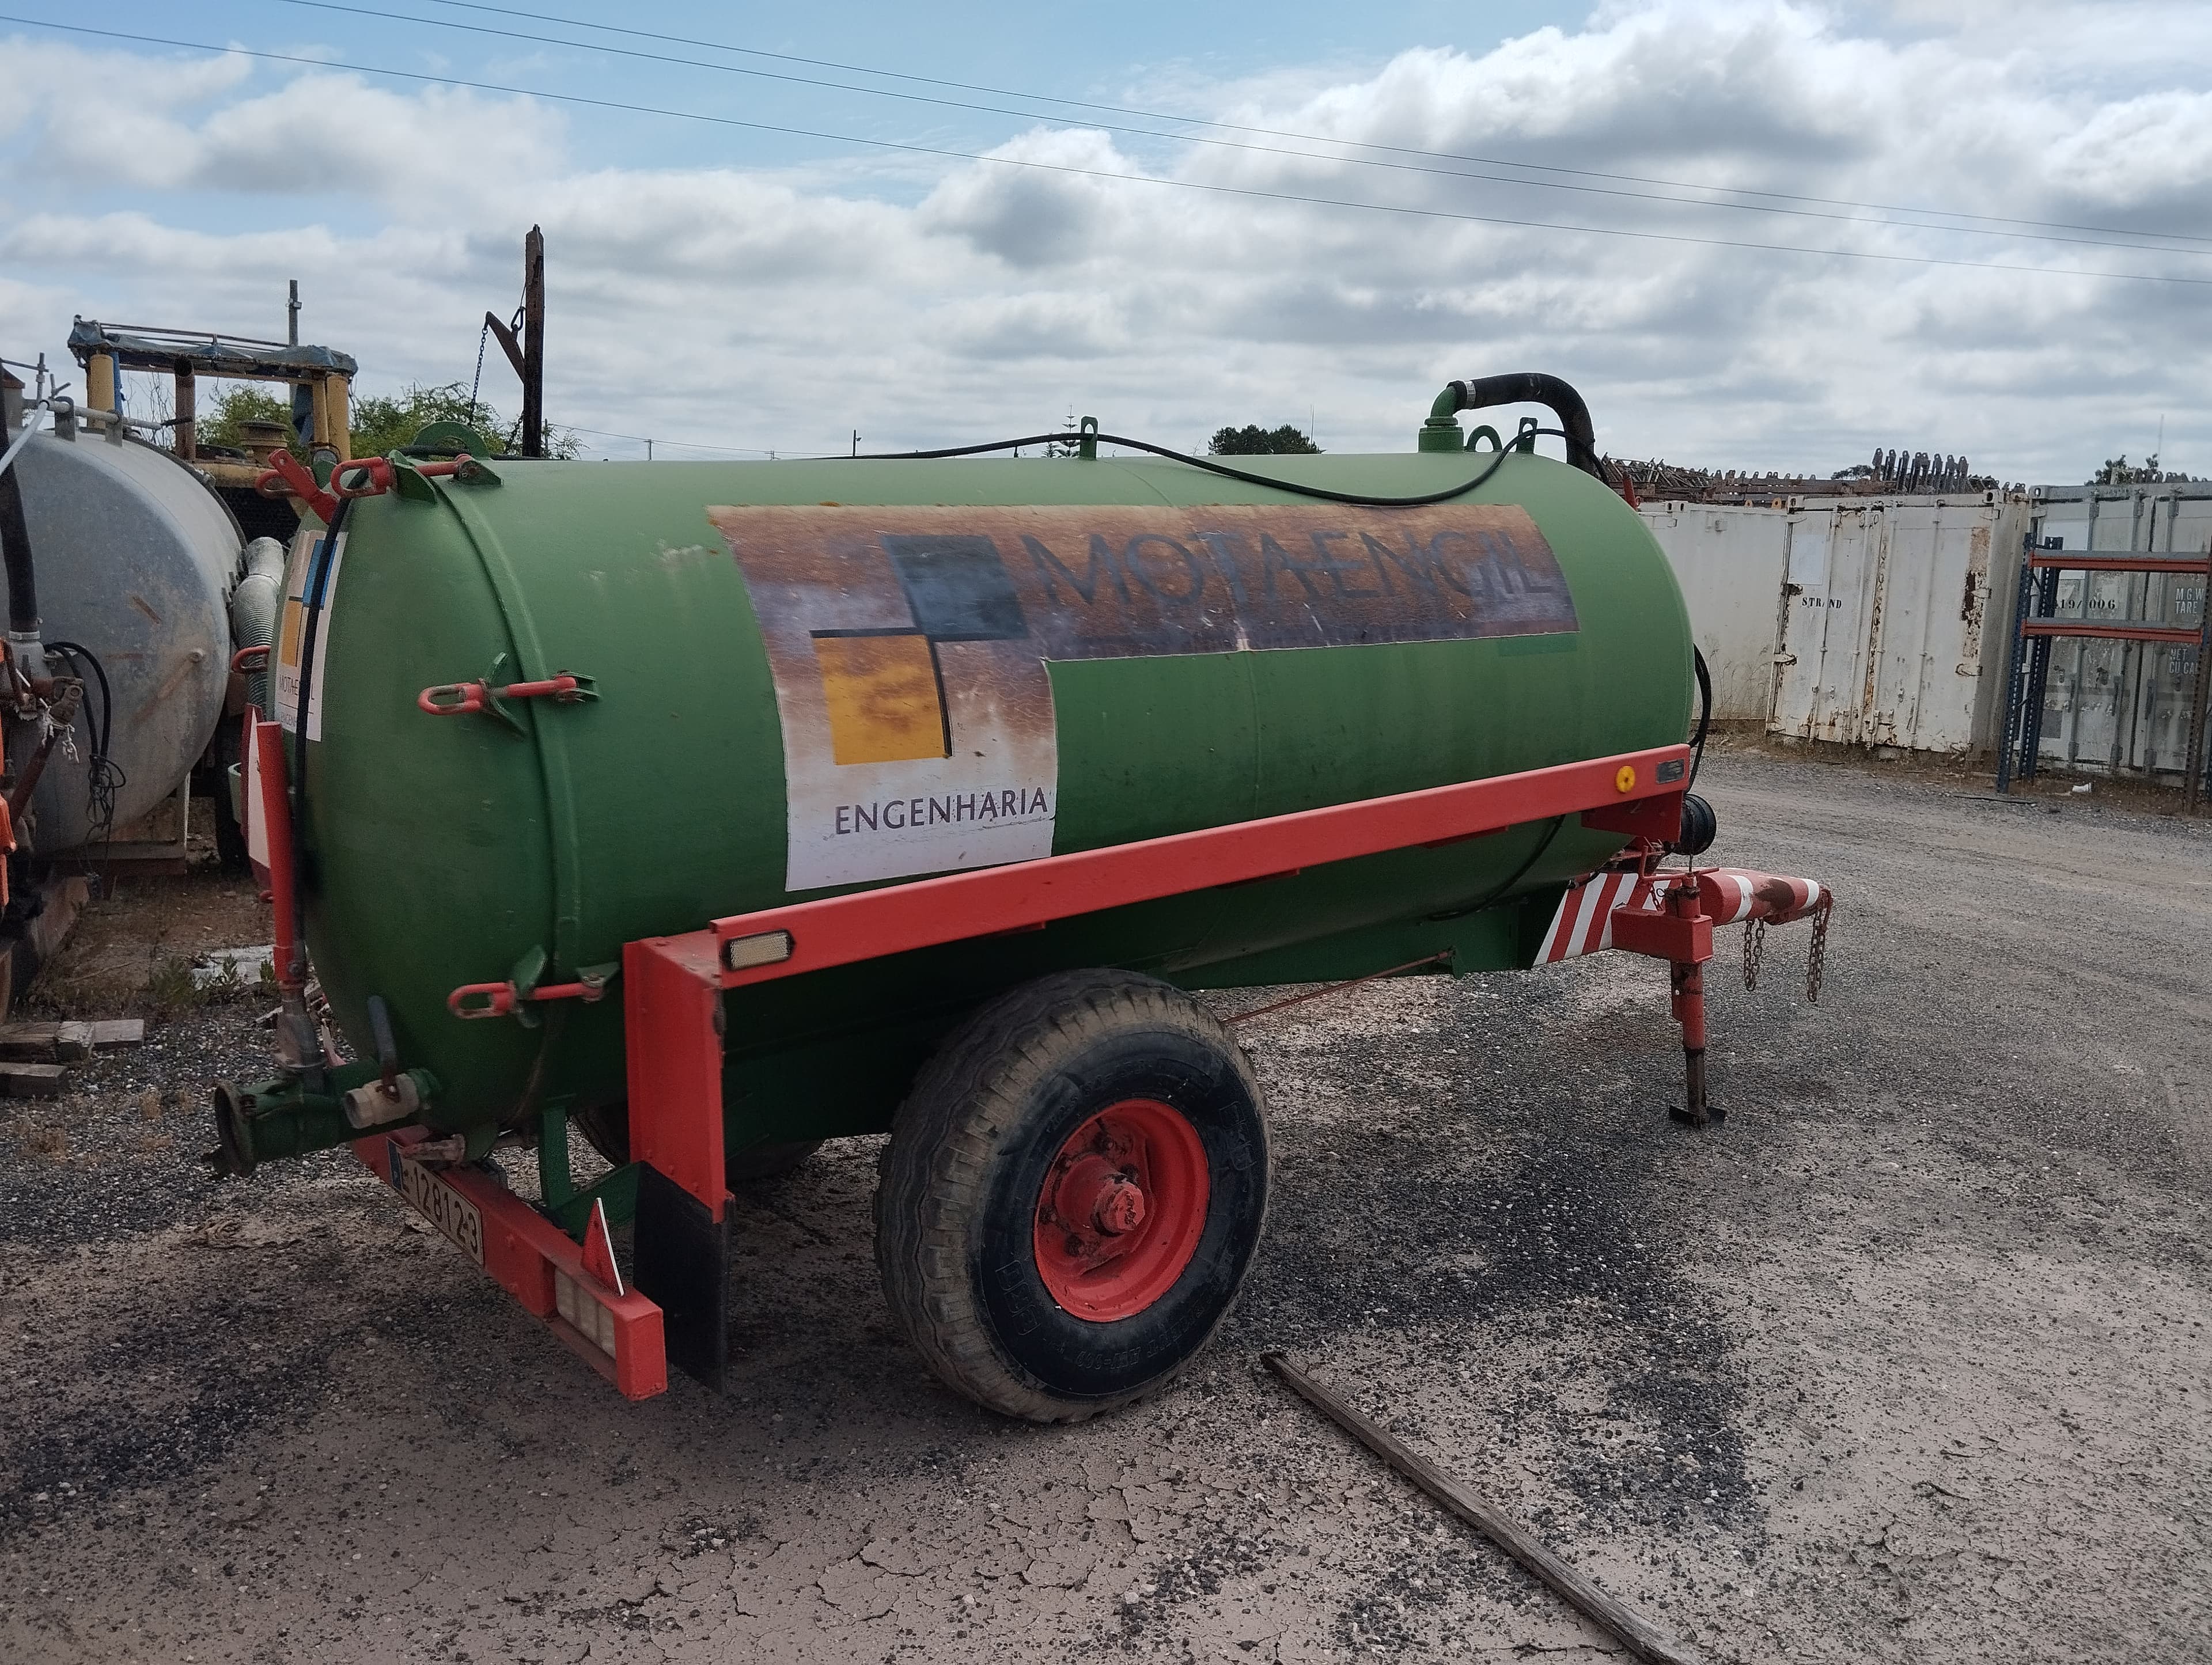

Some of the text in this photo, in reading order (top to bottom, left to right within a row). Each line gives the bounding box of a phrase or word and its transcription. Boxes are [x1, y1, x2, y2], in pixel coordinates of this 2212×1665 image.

[1020, 529, 1554, 607] MOTAENGIL
[1802, 597, 1842, 609] STRND
[2175, 601, 2198, 615] TARE
[2171, 648, 2187, 661] NET
[2169, 661, 2180, 674] CU
[835, 787, 1048, 835] ENGENHARIA
